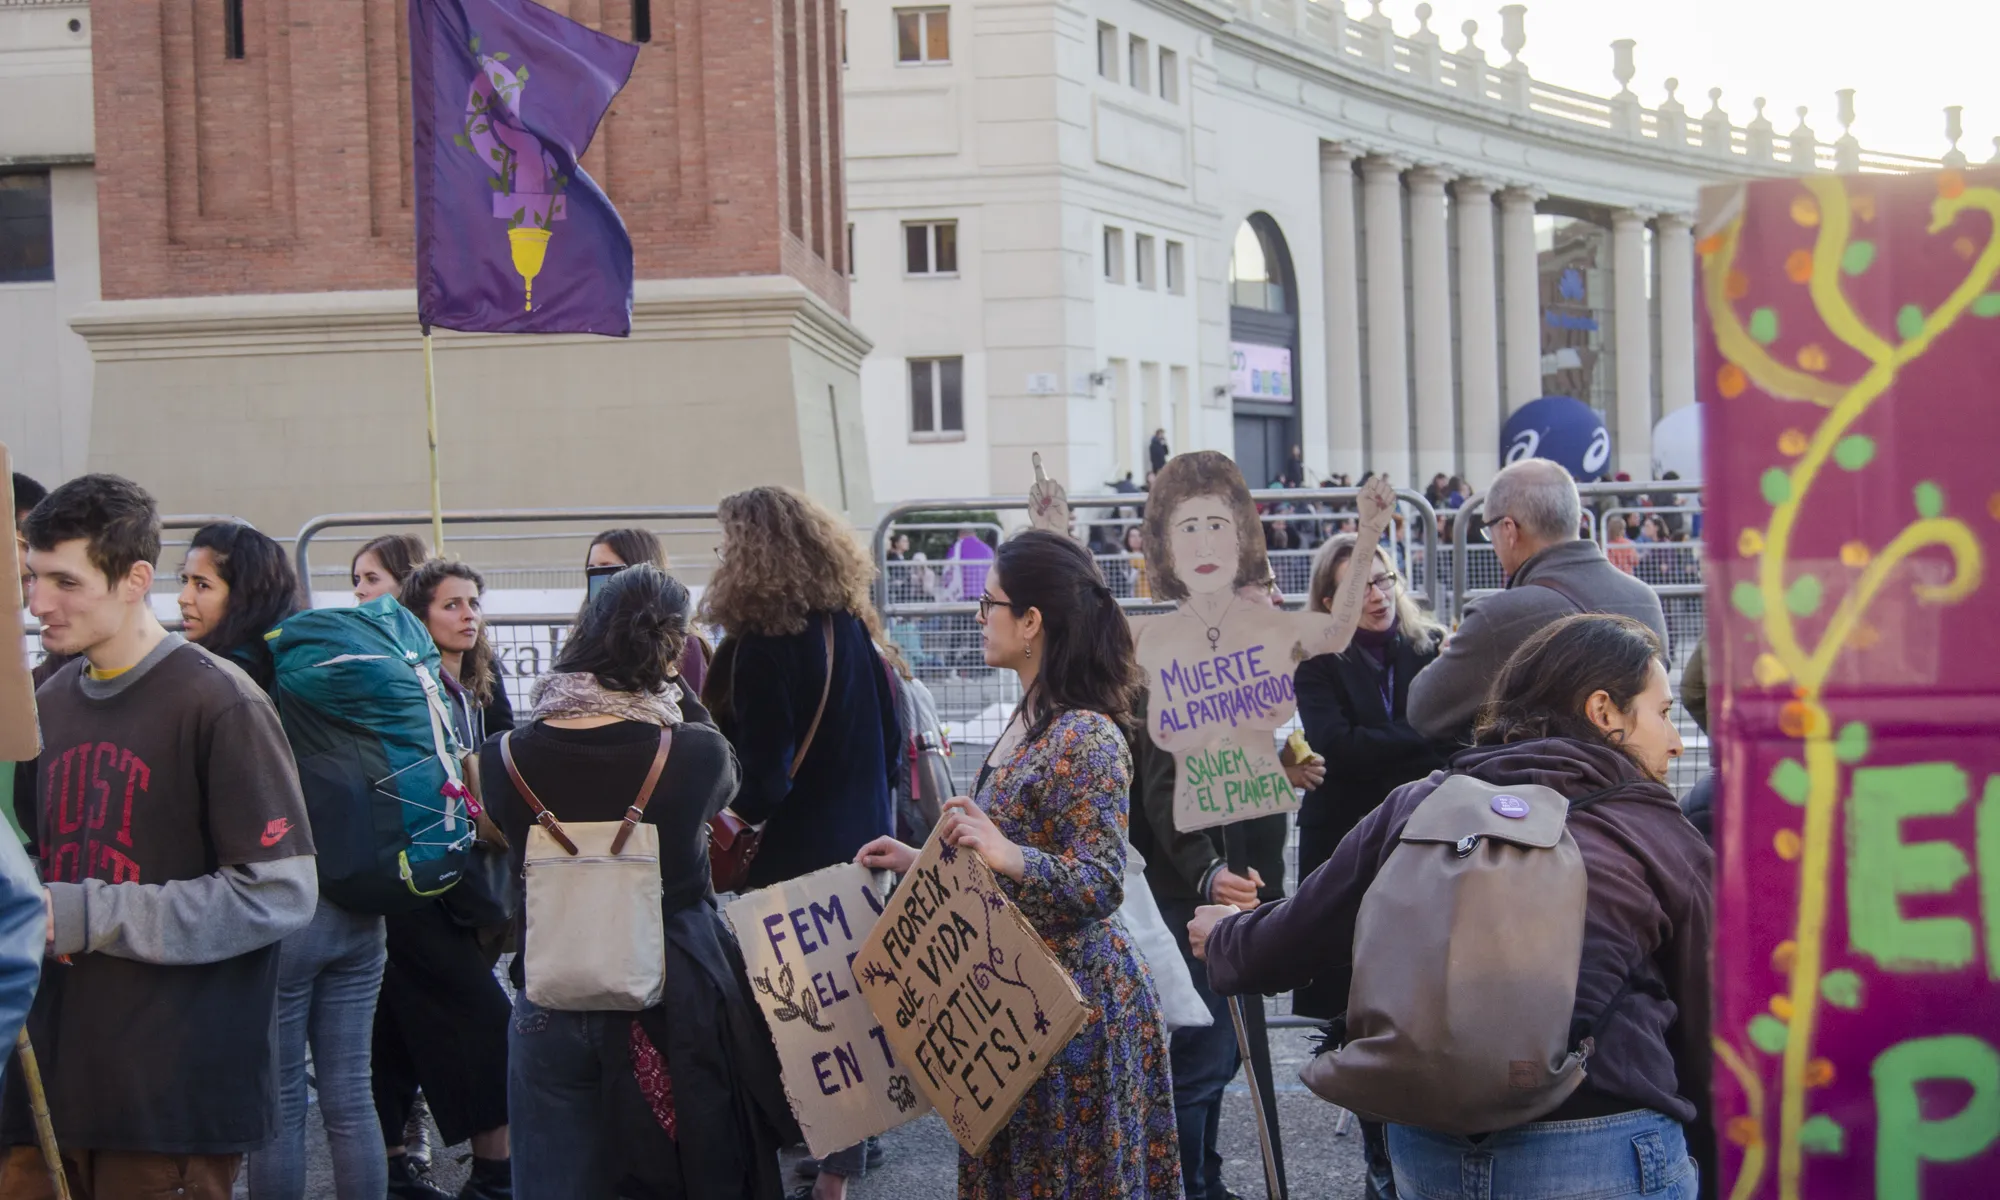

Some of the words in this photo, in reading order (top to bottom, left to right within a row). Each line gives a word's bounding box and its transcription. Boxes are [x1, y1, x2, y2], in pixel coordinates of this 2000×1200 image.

[1160, 645, 1270, 702] MUERTE
[1160, 708, 1188, 732] AL
[1187, 673, 1295, 729] PATRIARCADO
[1186, 746, 1254, 786] SALVEM
[1197, 786, 1220, 812] EL
[1223, 772, 1296, 813] PLANETA
[763, 894, 853, 966] FEM
[811, 970, 850, 1008] EL
[896, 976, 924, 1028] QUE
[811, 1041, 864, 1095] EN
[961, 1007, 1036, 1112] ETS!
